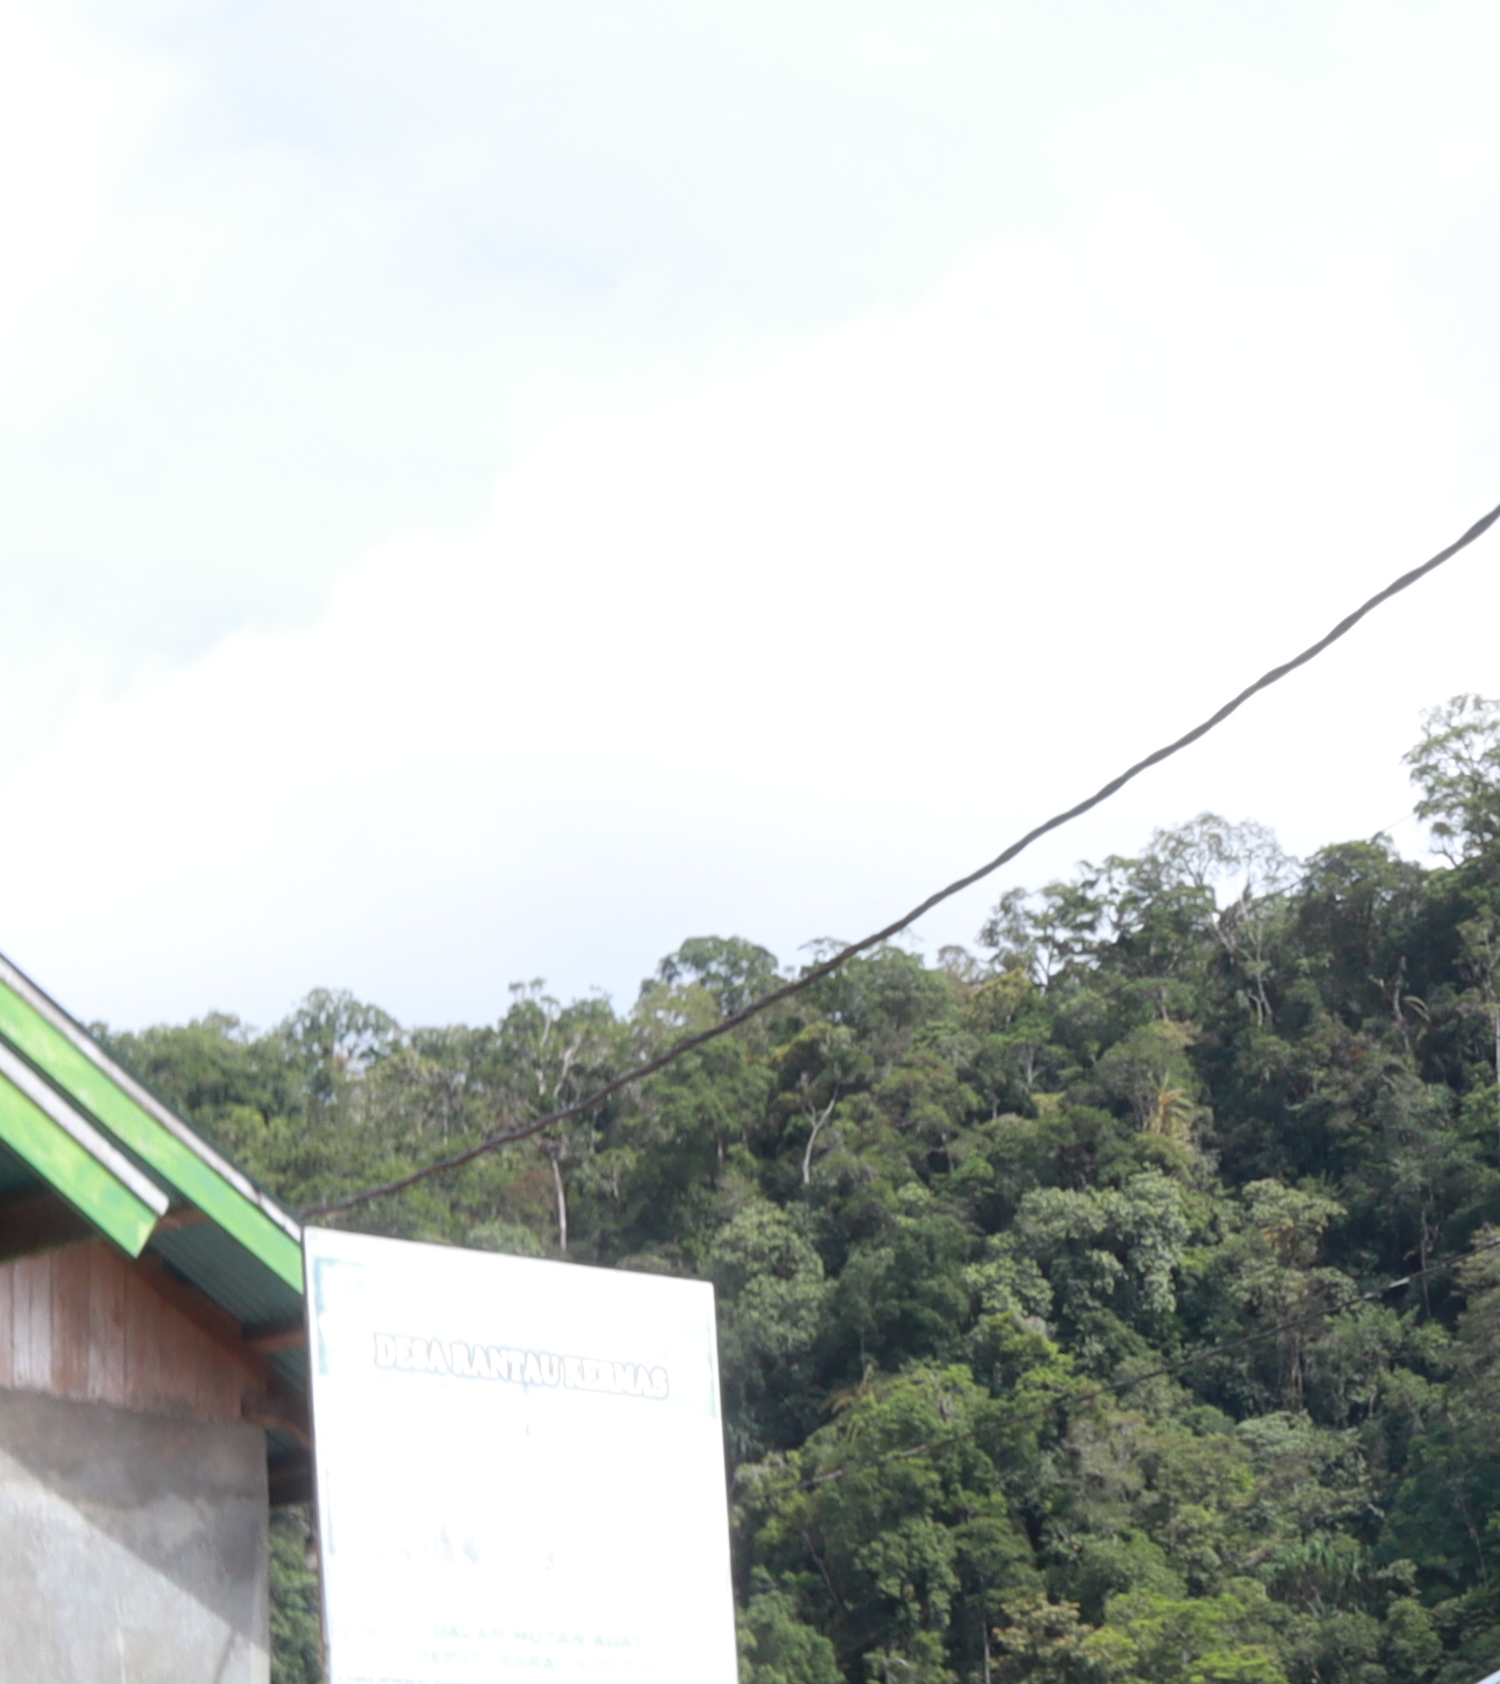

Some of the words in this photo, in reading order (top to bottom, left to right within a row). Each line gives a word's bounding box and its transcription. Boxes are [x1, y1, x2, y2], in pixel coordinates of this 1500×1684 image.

[373, 1332, 449, 1375] DESA
[450, 1340, 561, 1388] RANTAU
[562, 1355, 669, 1400] KERMAS
[416, 1648, 487, 1666] DEPAT
